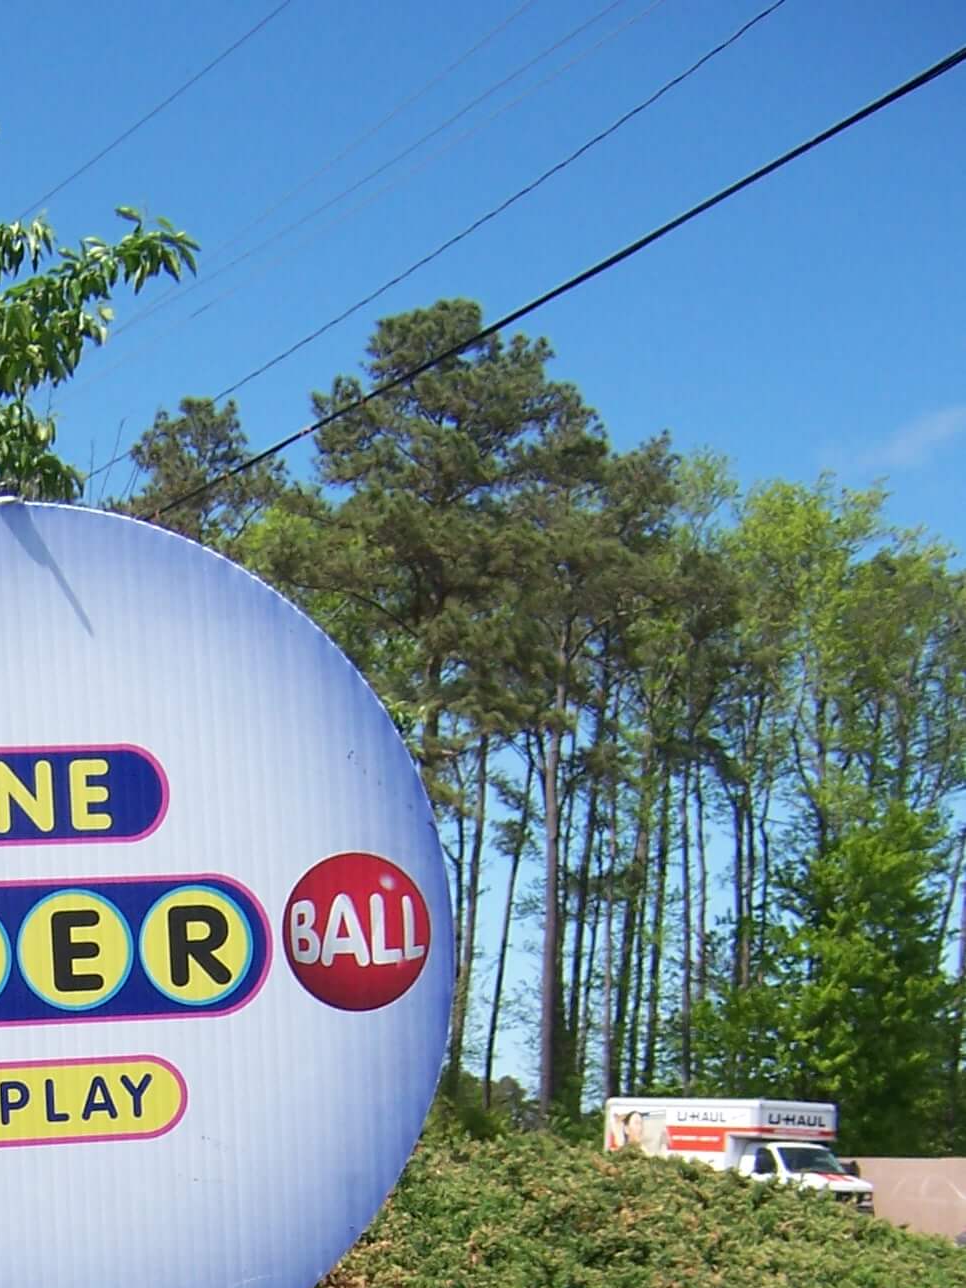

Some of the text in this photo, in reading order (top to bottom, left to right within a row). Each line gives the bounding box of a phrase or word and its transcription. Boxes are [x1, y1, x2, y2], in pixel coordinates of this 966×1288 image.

[291, 892, 425, 968] BALL
[0, 1071, 153, 1125] PLAY
[677, 1111, 727, 1123] U-HAUL
[768, 1112, 826, 1127] U-HAUL
